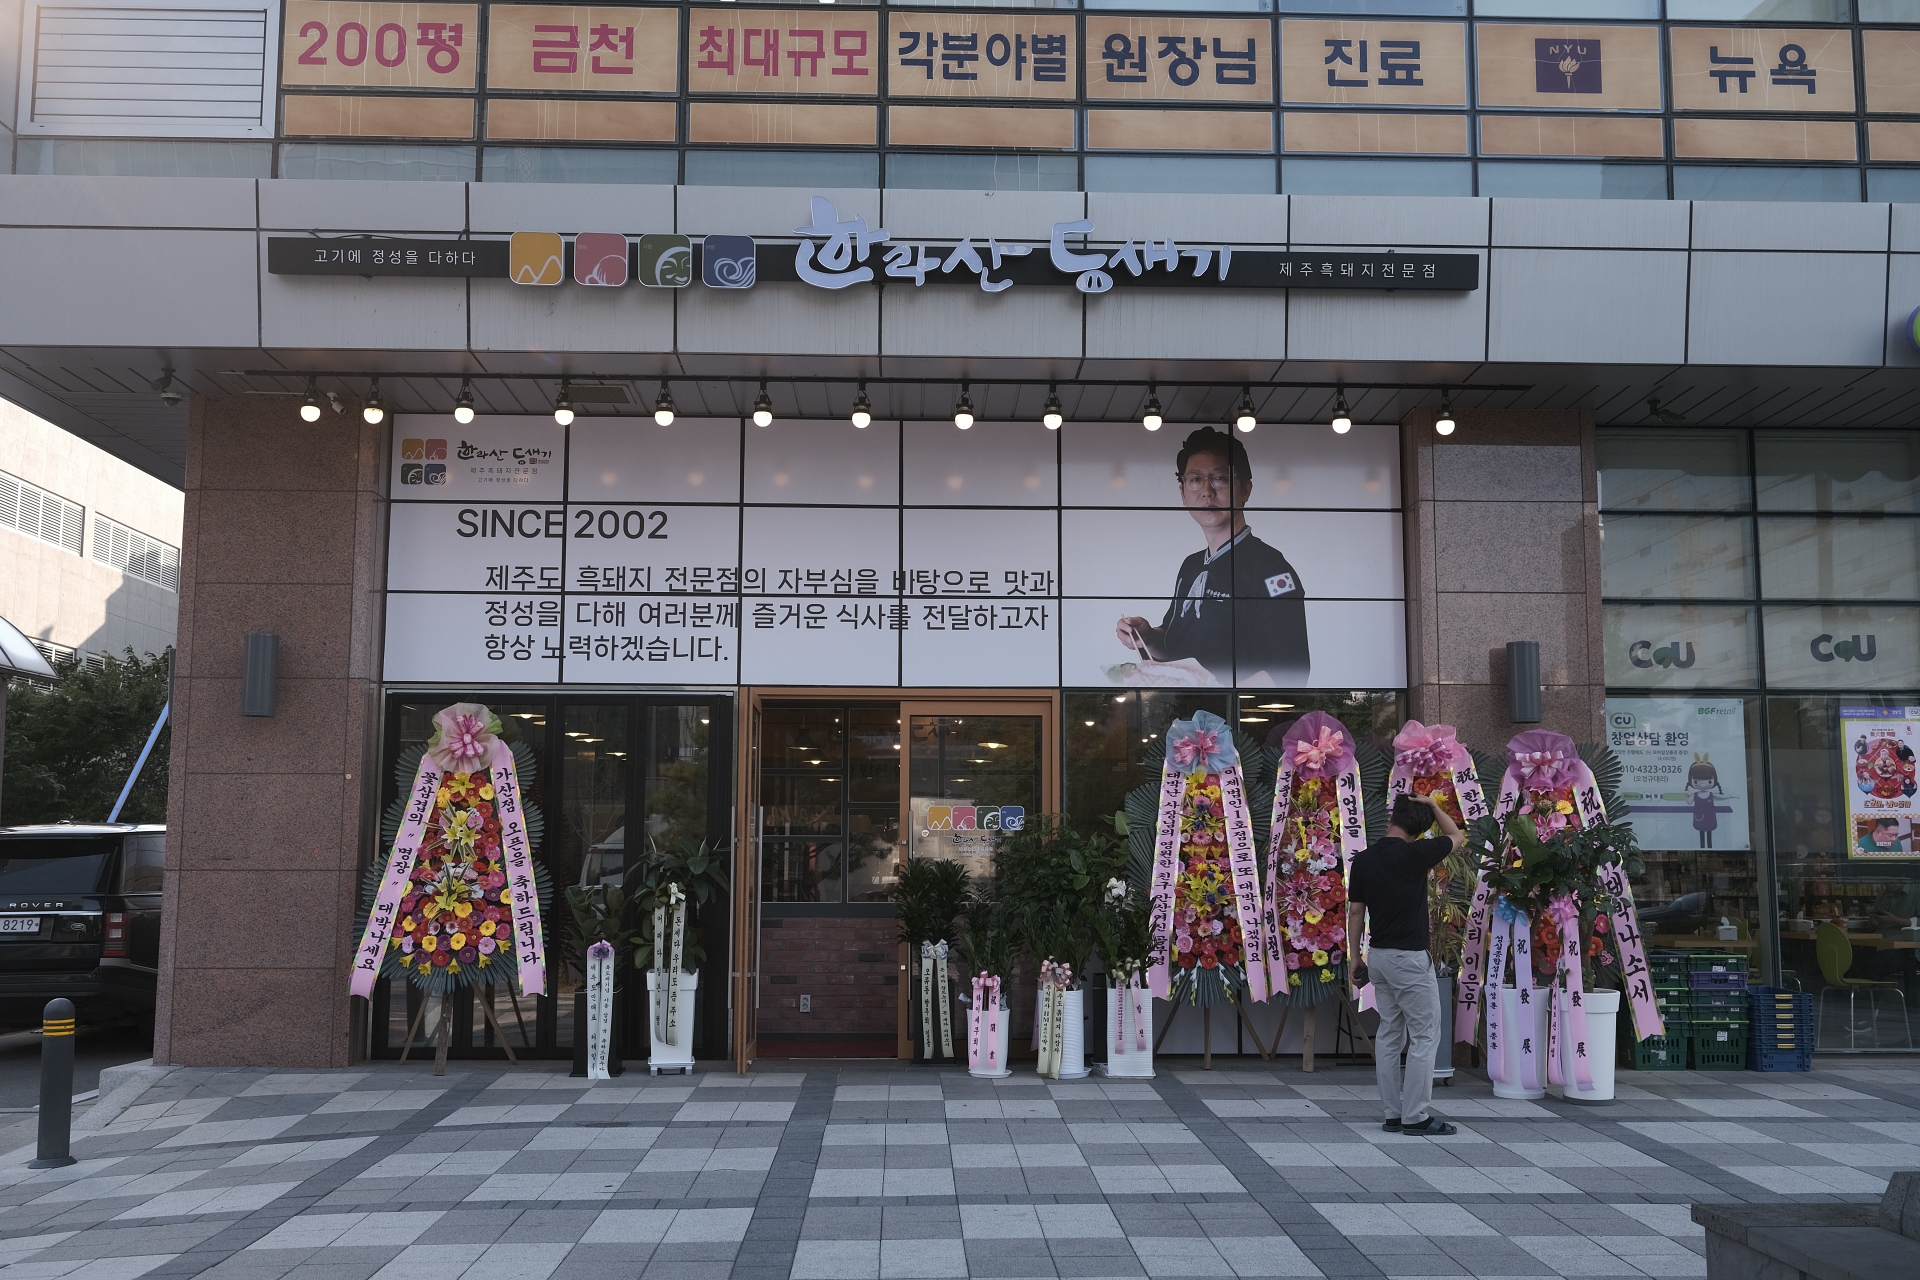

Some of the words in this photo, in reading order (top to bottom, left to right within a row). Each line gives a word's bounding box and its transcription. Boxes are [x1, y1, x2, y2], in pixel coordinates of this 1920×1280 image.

[297, 21, 464, 74] 200평
[531, 24, 636, 76] 금천
[697, 26, 869, 78] 최대규모
[897, 30, 1067, 83] 각분야별
[1101, 32, 1257, 87] 원장님
[1324, 38, 1424, 88] 진료
[1548, 44, 1588, 56] NYU
[1708, 43, 1817, 95] 뉴욕
[314, 248, 361, 265] 고기에
[372, 248, 419, 266] 정성을
[428, 250, 476, 266] 다하다
[792, 195, 1033, 293] 한라산
[1279, 261, 1438, 280] 제주흑돼지전문점
[456, 508, 564, 538] SINCE
[574, 510, 668, 539] 2002
[485, 565, 562, 591] 제주도
[576, 565, 651, 592] 흑돼지
[665, 566, 766, 593] 전문점의
[778, 567, 879, 594] 자부심을
[892, 569, 991, 595] 바탕으로
[1004, 569, 1054, 595] 맛과
[484, 600, 561, 627] 정성을
[576, 601, 625, 627] 다해
[638, 602, 738, 628] 여러분께
[753, 603, 828, 629] 즐거운
[836, 603, 911, 630] 식사를
[923, 604, 1048, 631] 전달하고자
[484, 634, 535, 661] 항상
[541, 635, 729, 662] 노력하겠습니다.
[1629, 640, 1696, 669] CU
[1810, 633, 1877, 662] CU
[1614, 716, 1632, 725] CU
[1611, 732, 1661, 746] 창업상담
[1664, 732, 1689, 746] 환영
[1166, 772, 1182, 798] 대박난
[1621, 765, 1682, 774] 010-4323-0326
[496, 768, 516, 813] 가산점
[1340, 772, 1359, 838] 개업을
[1160, 800, 1180, 837] 사장님의
[505, 822, 527, 867] 오픈을
[1160, 840, 1174, 868] 영원한
[1268, 833, 1281, 872] 친구야
[1155, 872, 1172, 890] 친구
[1237, 867, 1254, 877] 또
[1238, 881, 1258, 913] 대박이
[3, 919, 34, 931] 8219
[513, 875, 540, 965] 축하드립니다
[357, 902, 394, 971] 대박나세요
[1245, 918, 1262, 963] 나겠어요
[1605, 872, 1649, 1003] 대박나소서
[1458, 952, 1480, 1012] 이은우
